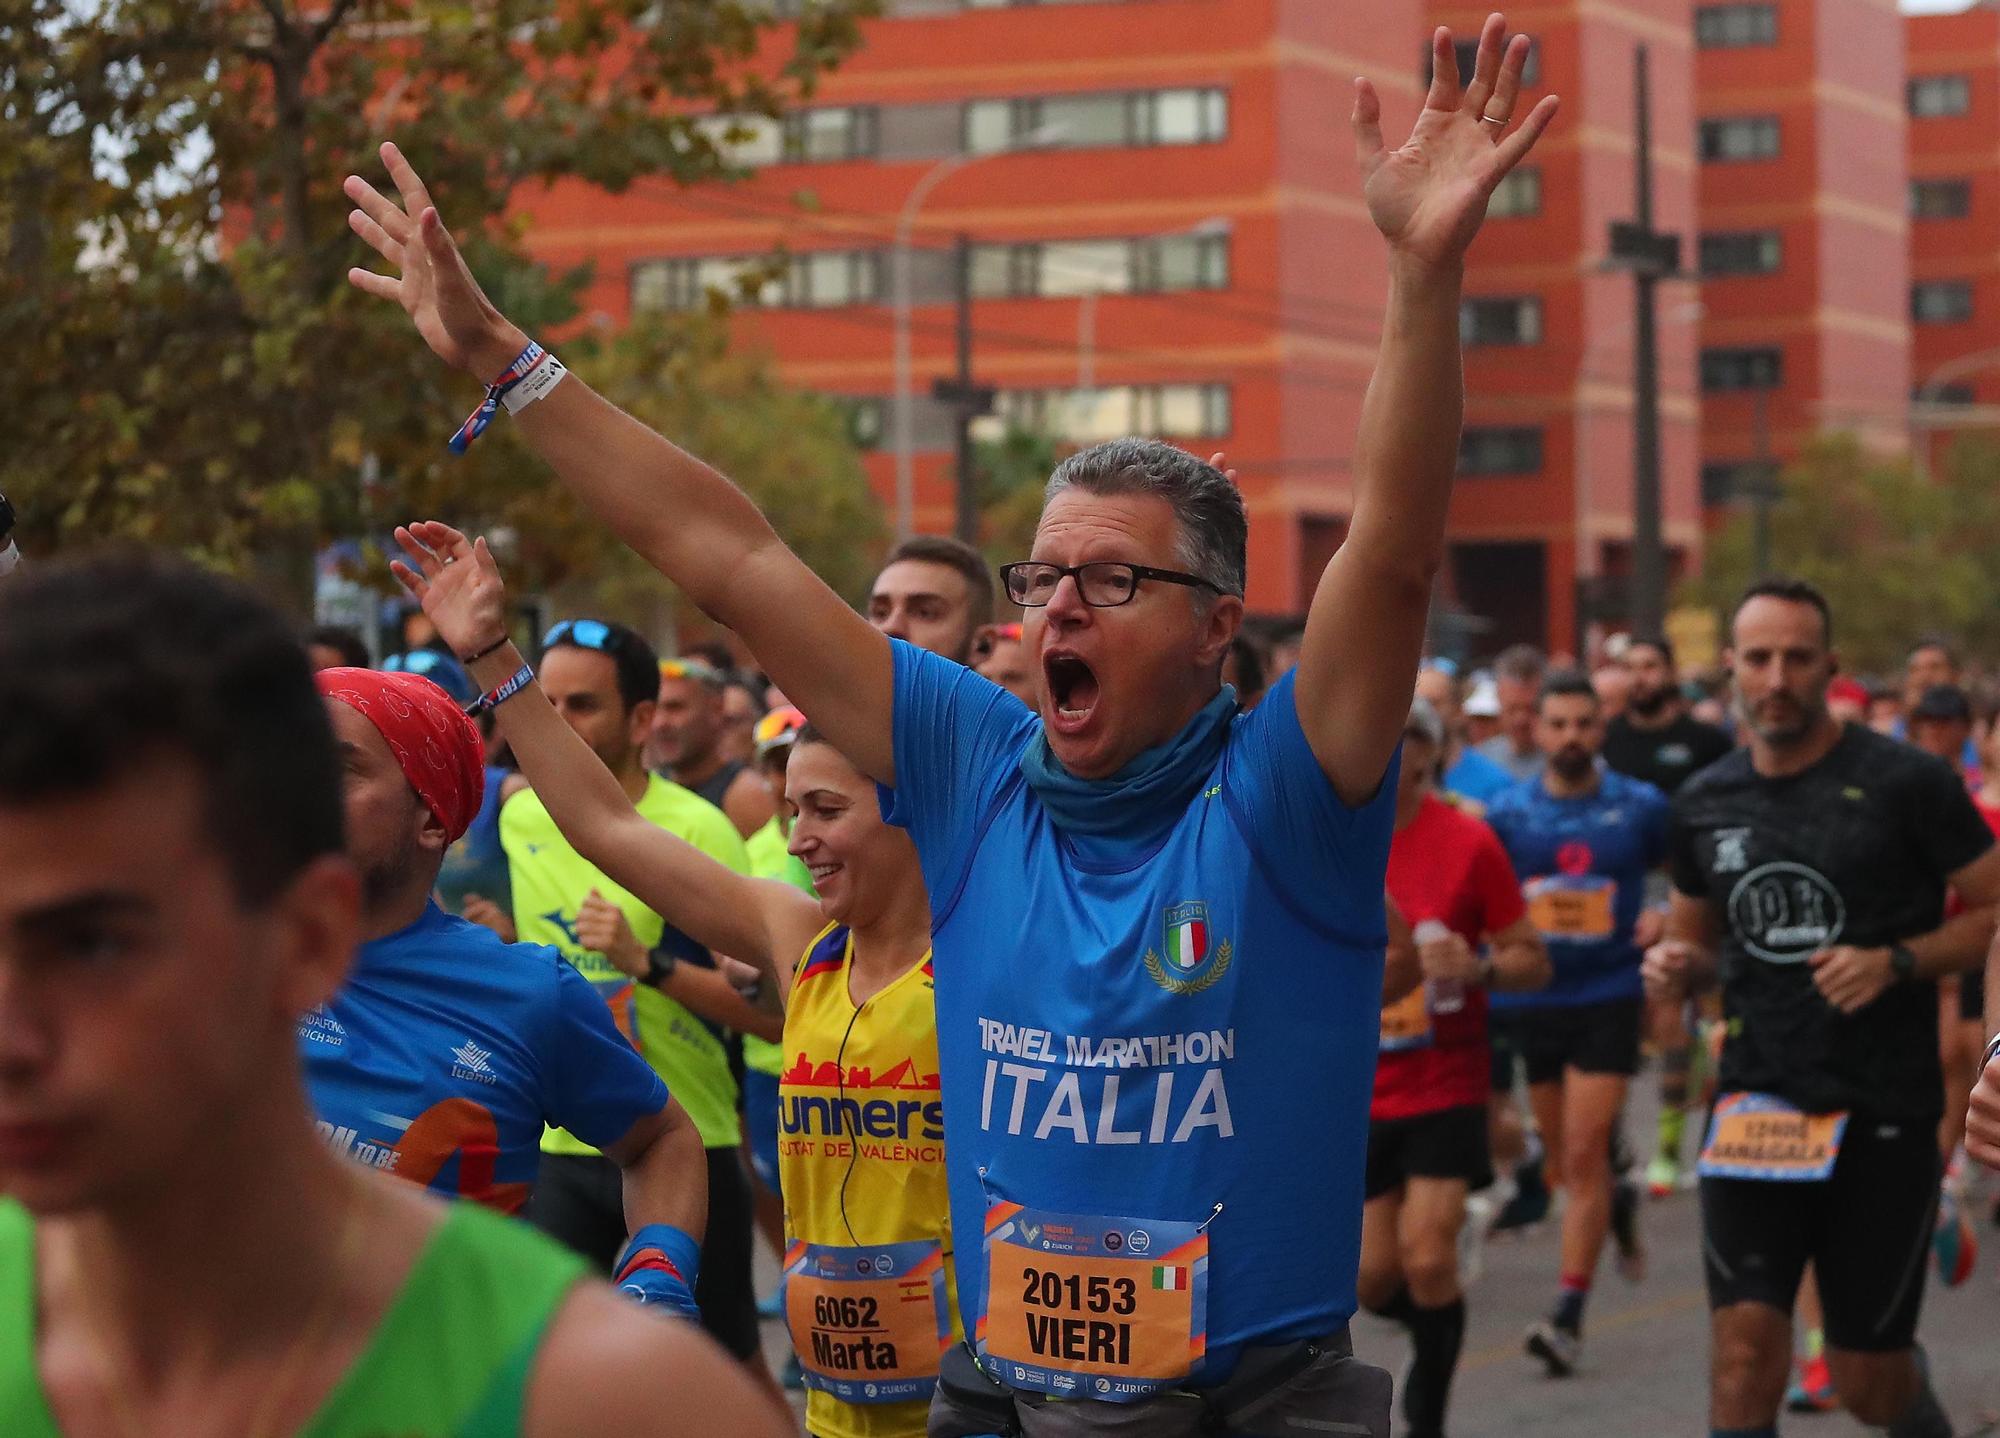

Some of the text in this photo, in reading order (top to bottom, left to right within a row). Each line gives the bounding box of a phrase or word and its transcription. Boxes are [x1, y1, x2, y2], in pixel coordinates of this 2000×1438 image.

[496, 676, 518, 702] FAST
[1066, 1028, 1234, 1069] MARATHON
[450, 1064, 497, 1085] luanvi
[980, 1059, 1235, 1144] ITALIA
[375, 1148, 401, 1170] BE
[824, 1142, 852, 1157] DE
[859, 1142, 946, 1163] VALÈNCI
[1023, 1267, 1136, 1315] 20153
[815, 1294, 880, 1328] 6062
[811, 1331, 898, 1371] Marta
[1026, 1312, 1131, 1365] VIERI
[881, 1383, 917, 1395] ZURICH
